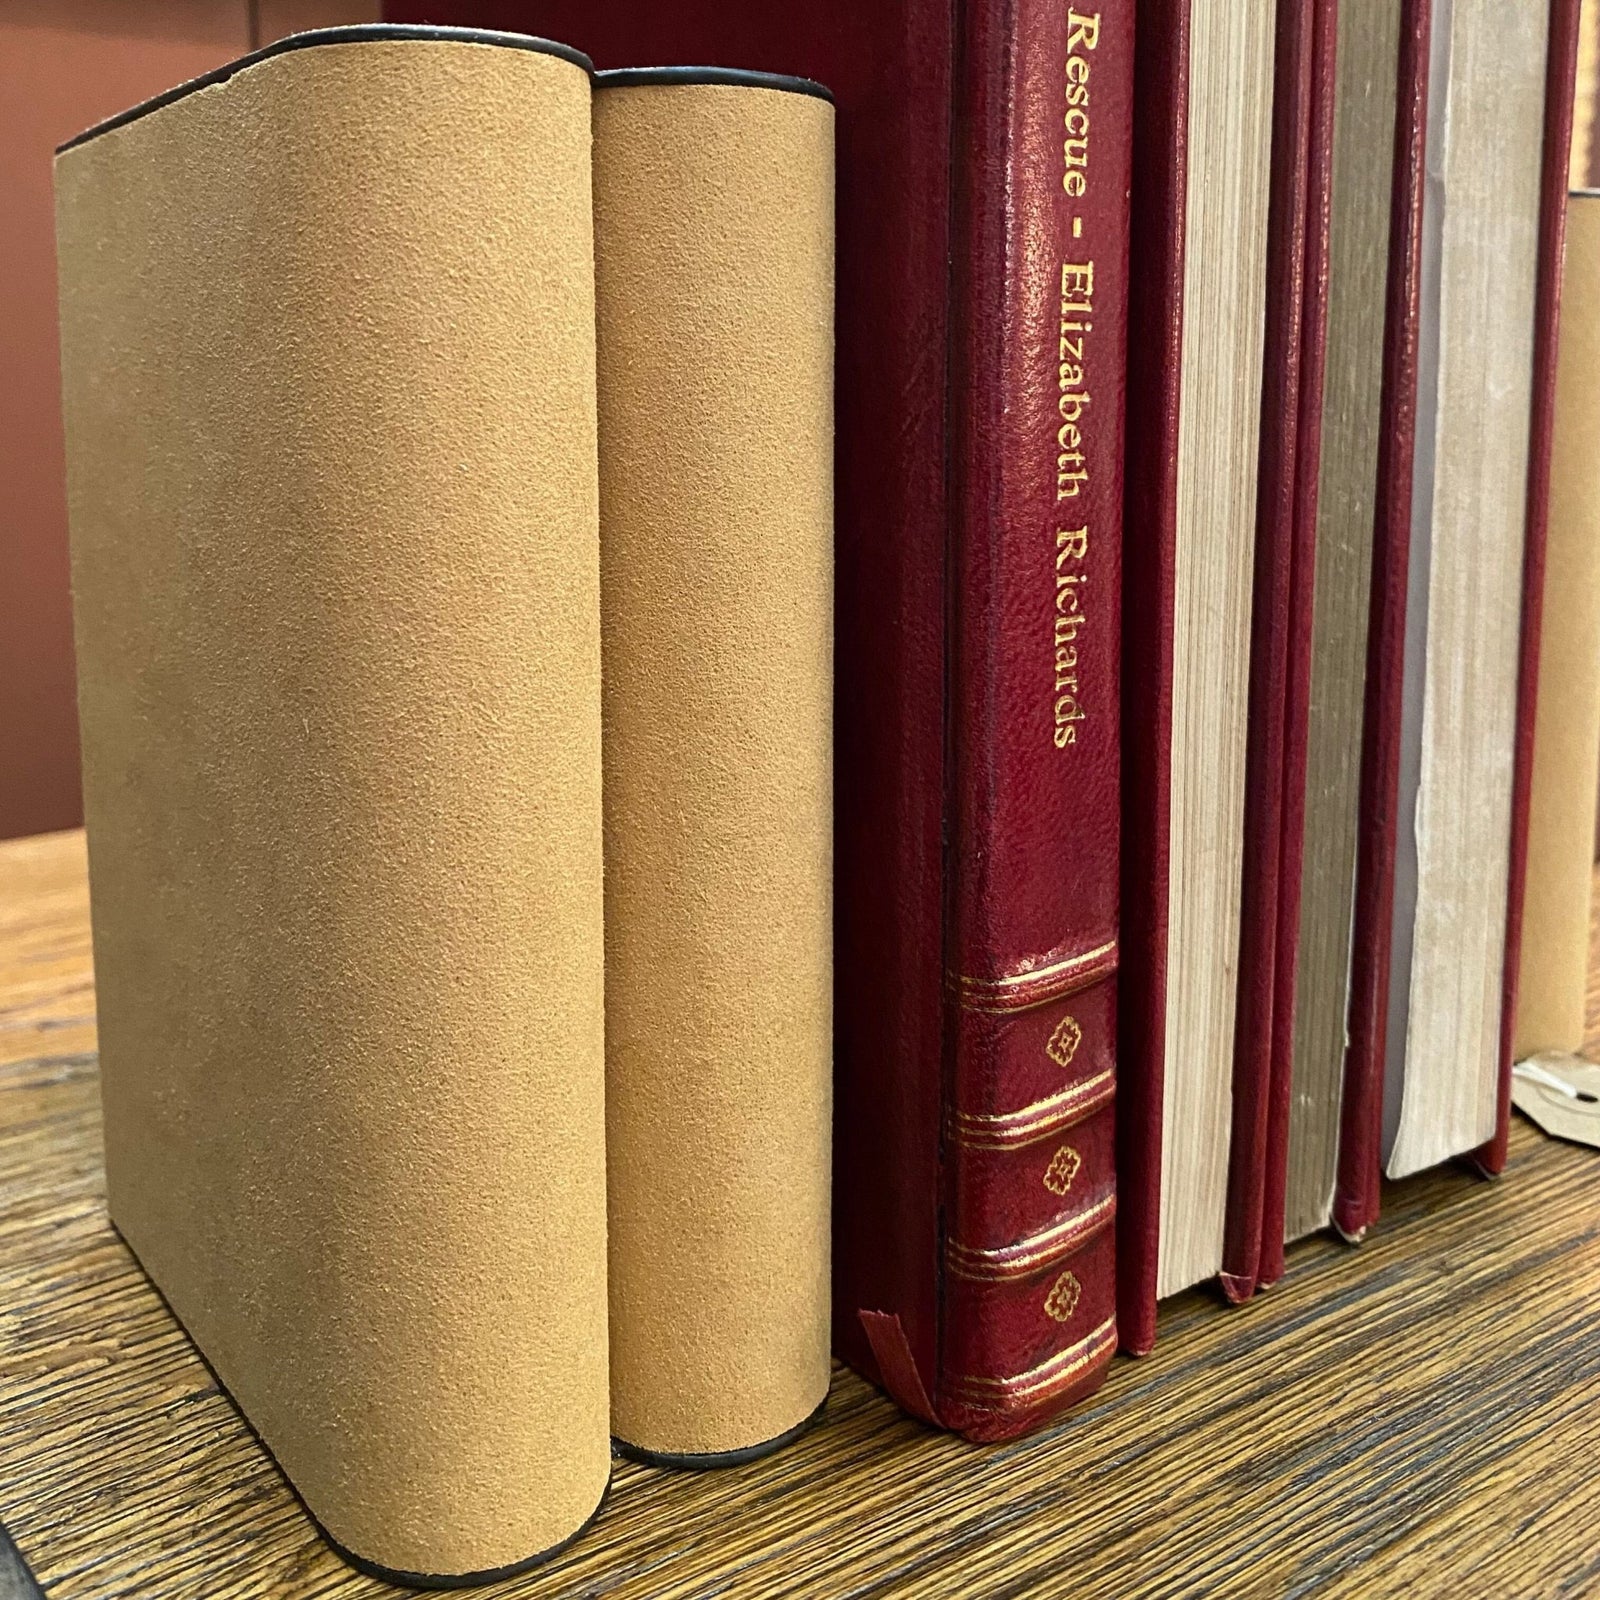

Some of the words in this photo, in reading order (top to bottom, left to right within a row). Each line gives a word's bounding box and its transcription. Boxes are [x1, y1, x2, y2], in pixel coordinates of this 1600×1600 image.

[1062, 6, 1100, 198] Rescue
[1072, 216, 1082, 238] -
[1056, 260, 1094, 501] Elizabeth
[1053, 525, 1088, 748] Richards
